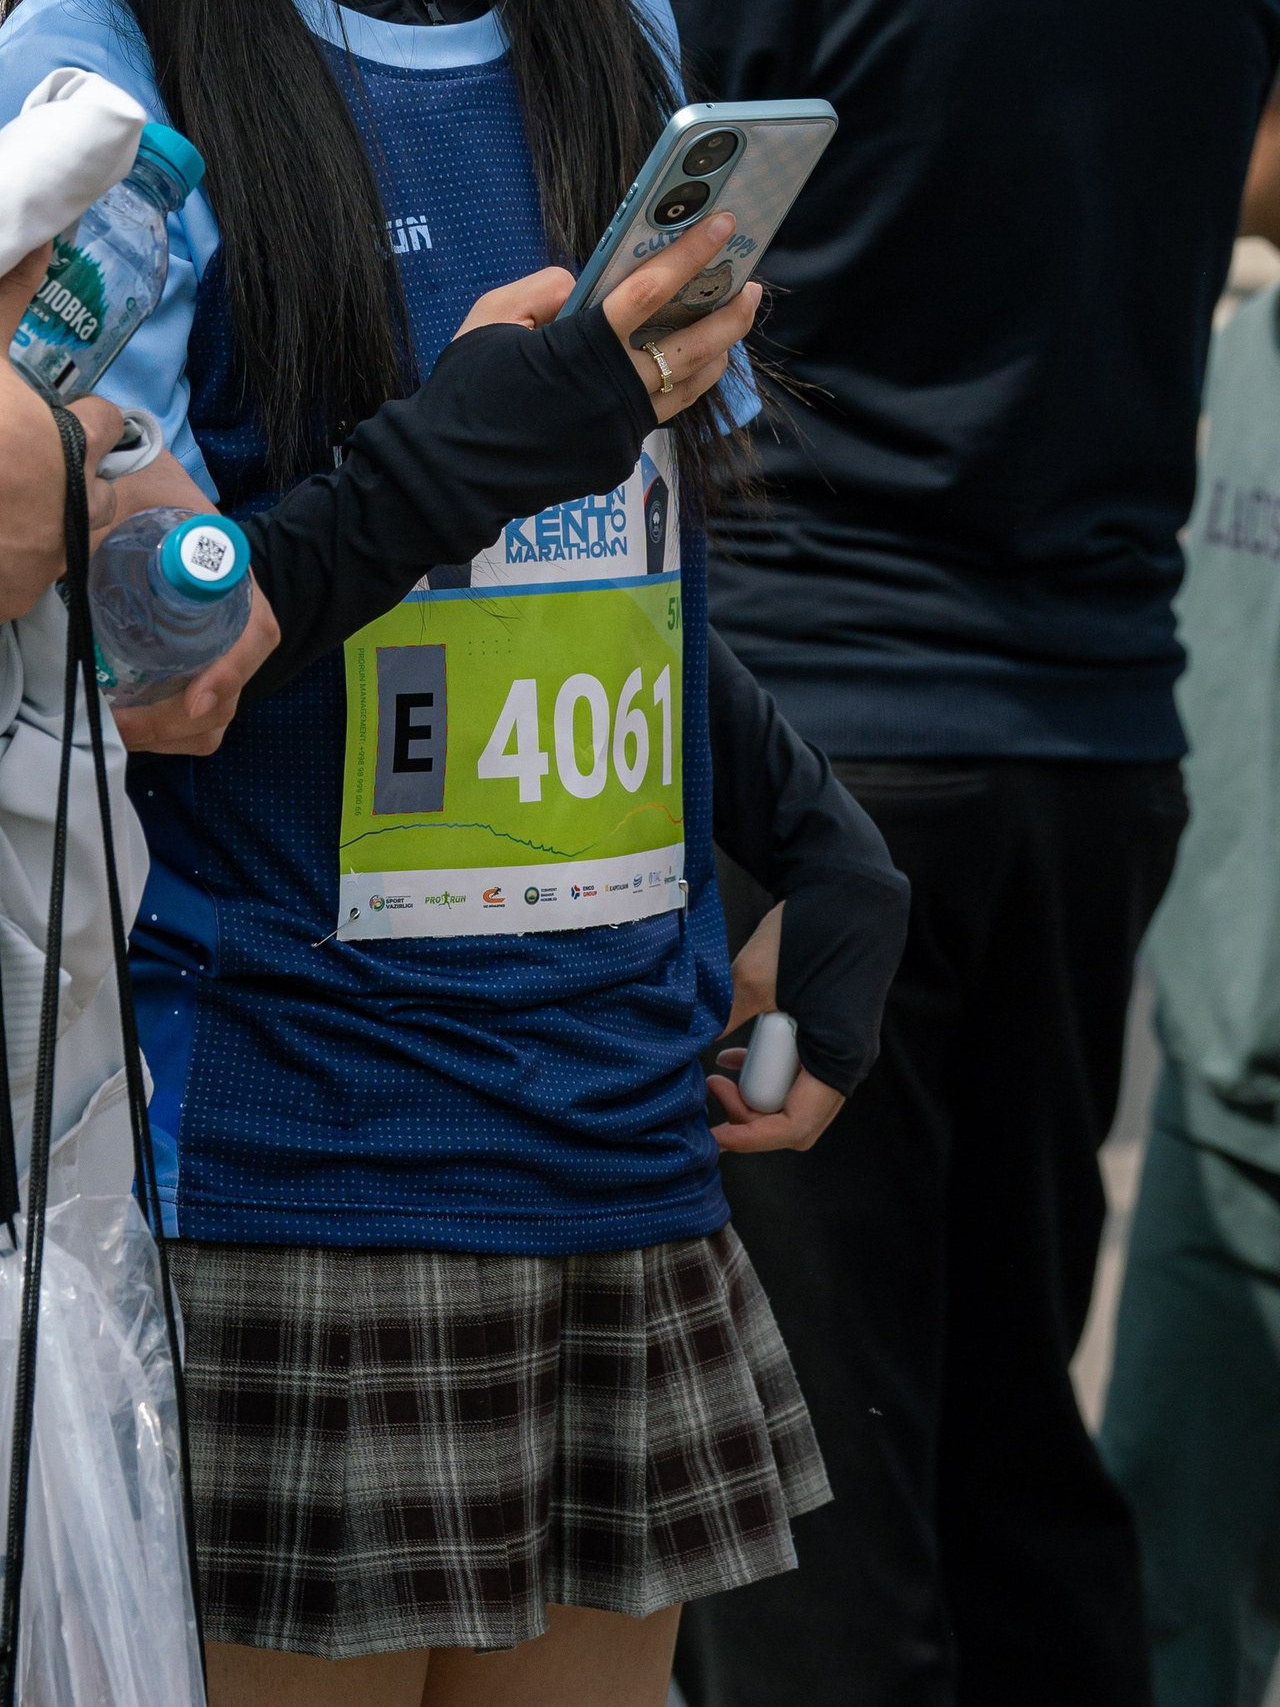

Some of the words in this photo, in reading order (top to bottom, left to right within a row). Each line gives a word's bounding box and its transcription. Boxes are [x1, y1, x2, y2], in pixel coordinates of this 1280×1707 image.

[386, 215, 433, 254] UN
[633, 231, 682, 258] cut
[506, 541, 619, 564] MARATHON
[358, 648, 366, 682] PRORUN
[392, 692, 434, 773] E
[477, 663, 672, 802] 4061
[357, 746, 365, 766] +998
[356, 767, 364, 778] 98
[356, 779, 364, 793] 999
[355, 795, 363, 805] 00
[424, 897, 441, 905] PRO
[450, 895, 467, 903] RUN
